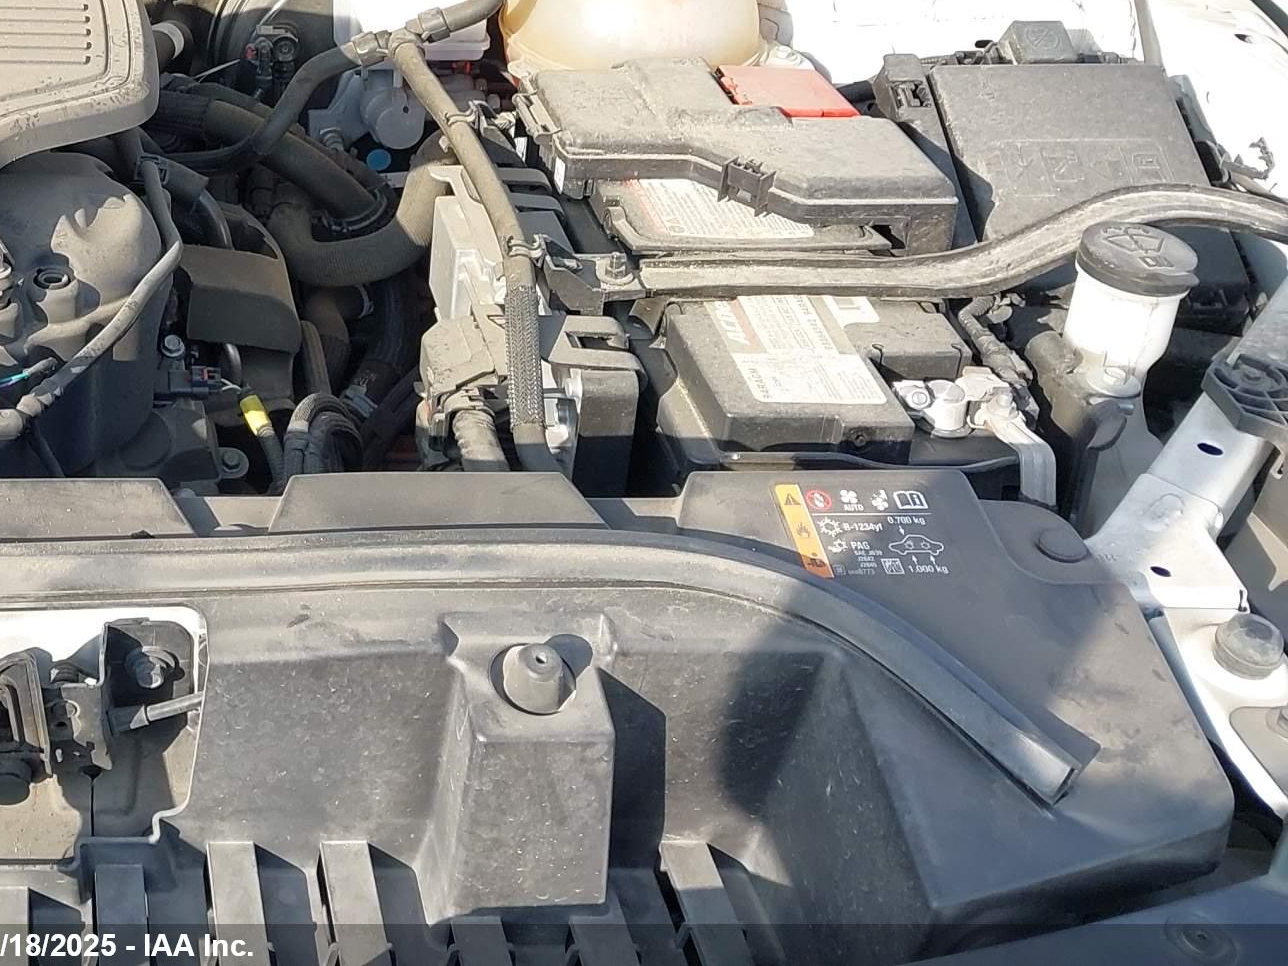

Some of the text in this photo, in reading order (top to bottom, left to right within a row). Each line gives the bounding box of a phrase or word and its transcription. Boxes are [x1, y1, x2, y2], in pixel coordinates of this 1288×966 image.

[843, 503, 864, 512] AUTO
[887, 516, 926, 526] 0.700 kg
[850, 541, 870, 550] PAG
[936, 565, 949, 575] kg
